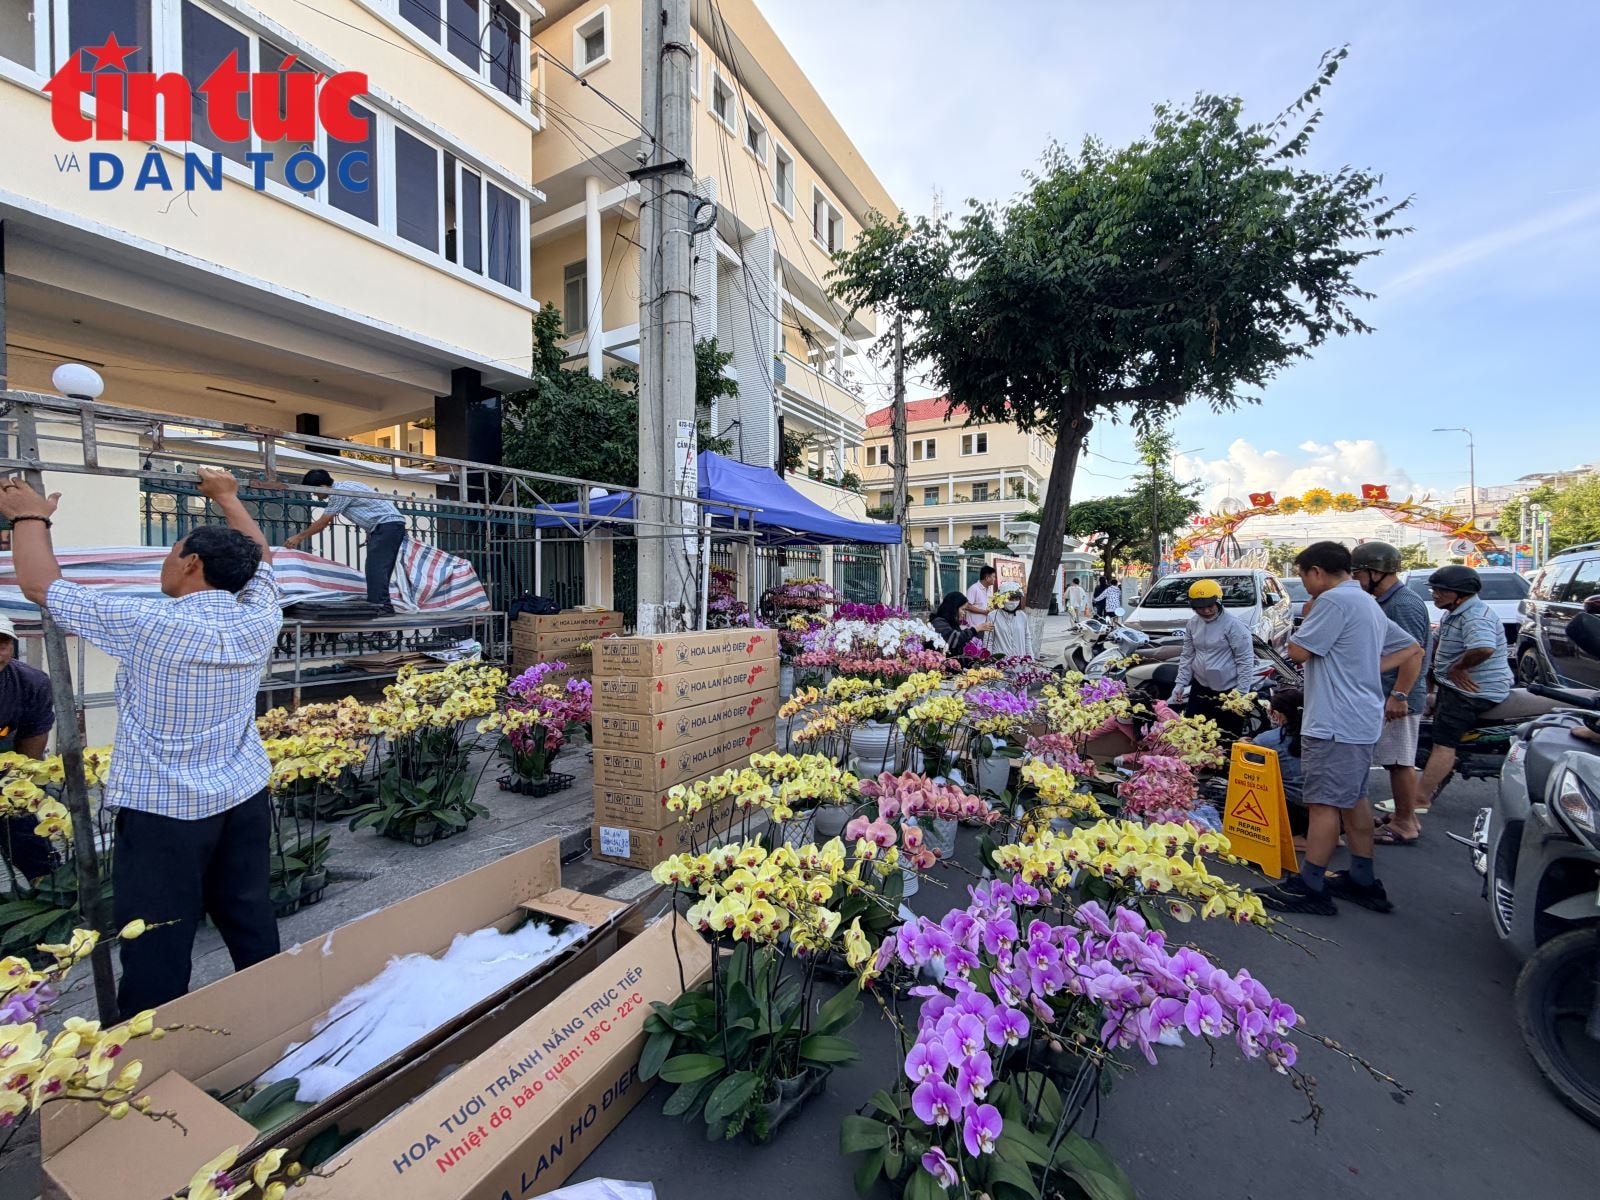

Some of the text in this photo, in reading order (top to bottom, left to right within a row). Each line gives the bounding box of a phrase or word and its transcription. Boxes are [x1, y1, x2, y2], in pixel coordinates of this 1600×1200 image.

[691, 647, 706, 657] HOA
[707, 645, 720, 655] LAN
[691, 682, 706, 692] HOA
[708, 679, 721, 689] LAN
[691, 718, 706, 728] HOA
[708, 713, 721, 723] LAN
[692, 751, 707, 763] HOA
[708, 746, 721, 757] LAN
[1236, 827, 1271, 843] PROGRESS
[1238, 821, 1261, 833] REPAIR
[392, 966, 643, 1174] HOA TƯƠI TRÁNH NẮNG TRỰC TIẾP
[435, 1126, 489, 1174] Nhiệt
[489, 1105, 512, 1128] độ
[512, 1080, 543, 1108] bảo
[544, 1046, 584, 1081] quản:
[583, 1020, 611, 1046] 18°C
[617, 992, 643, 1018] 22°C
[521, 1136, 563, 1193] LAN
